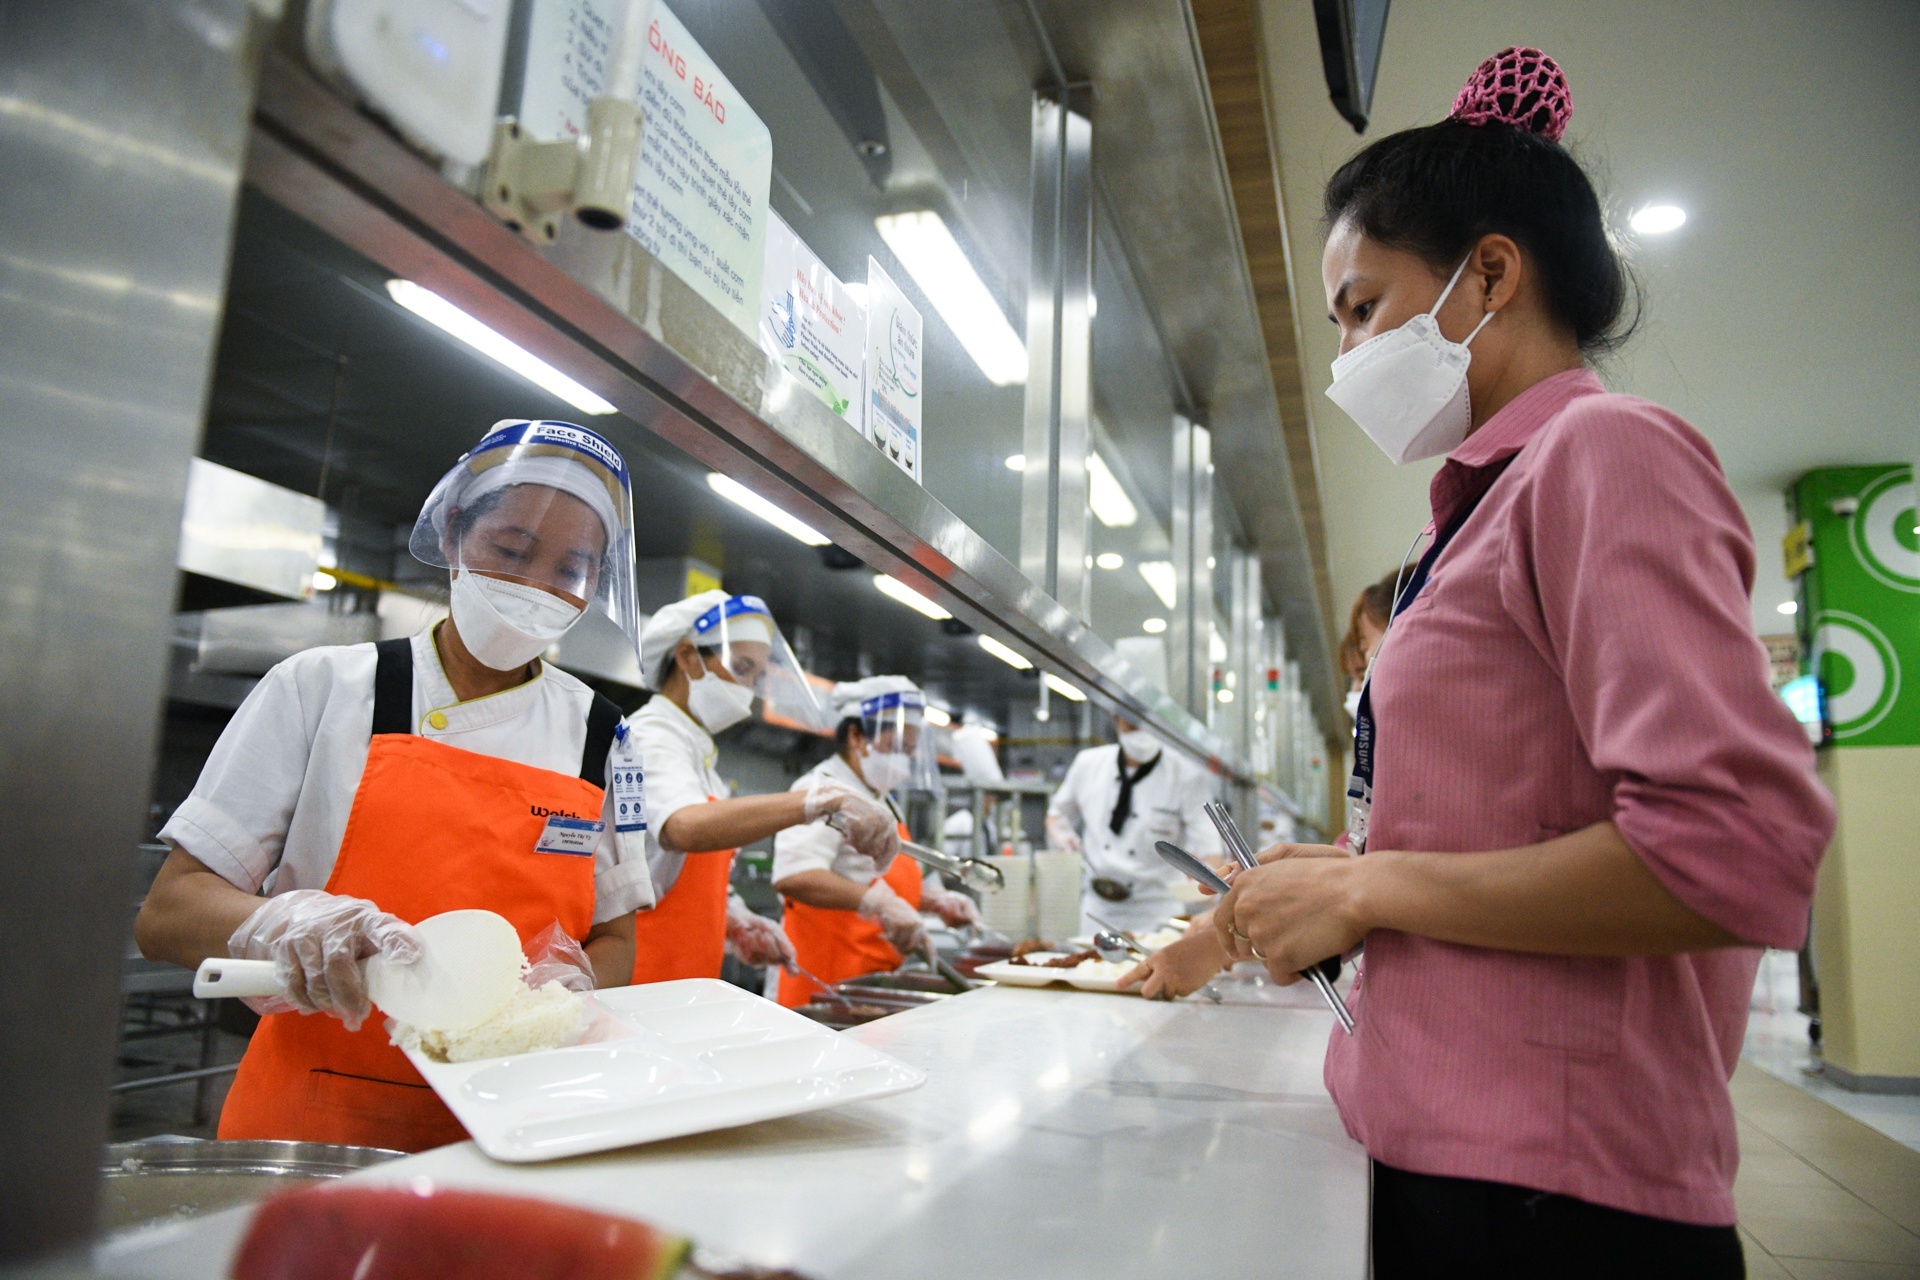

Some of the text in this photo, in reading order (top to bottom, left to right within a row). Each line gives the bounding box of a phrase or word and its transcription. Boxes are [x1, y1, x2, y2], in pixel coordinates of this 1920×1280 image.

[648, 19, 726, 125] ÔNG BÁO
[669, 97, 685, 117] cơm
[673, 117, 692, 147] thông
[704, 150, 717, 172] theo
[667, 177, 683, 197] cơm
[690, 153, 699, 171] khi
[717, 181, 726, 200] thẻ
[728, 191, 737, 212] lấy
[738, 208, 751, 225] cơm
[707, 193, 721, 216] giấy
[722, 211, 733, 226] xác
[734, 221, 749, 242] nhận
[730, 272, 743, 287] cơm
[816, 304, 840, 335] Protection
[536, 426, 621, 468] Face Shield
[544, 436, 577, 446] Protective
[1358, 715, 1371, 773] SAMSUNG
